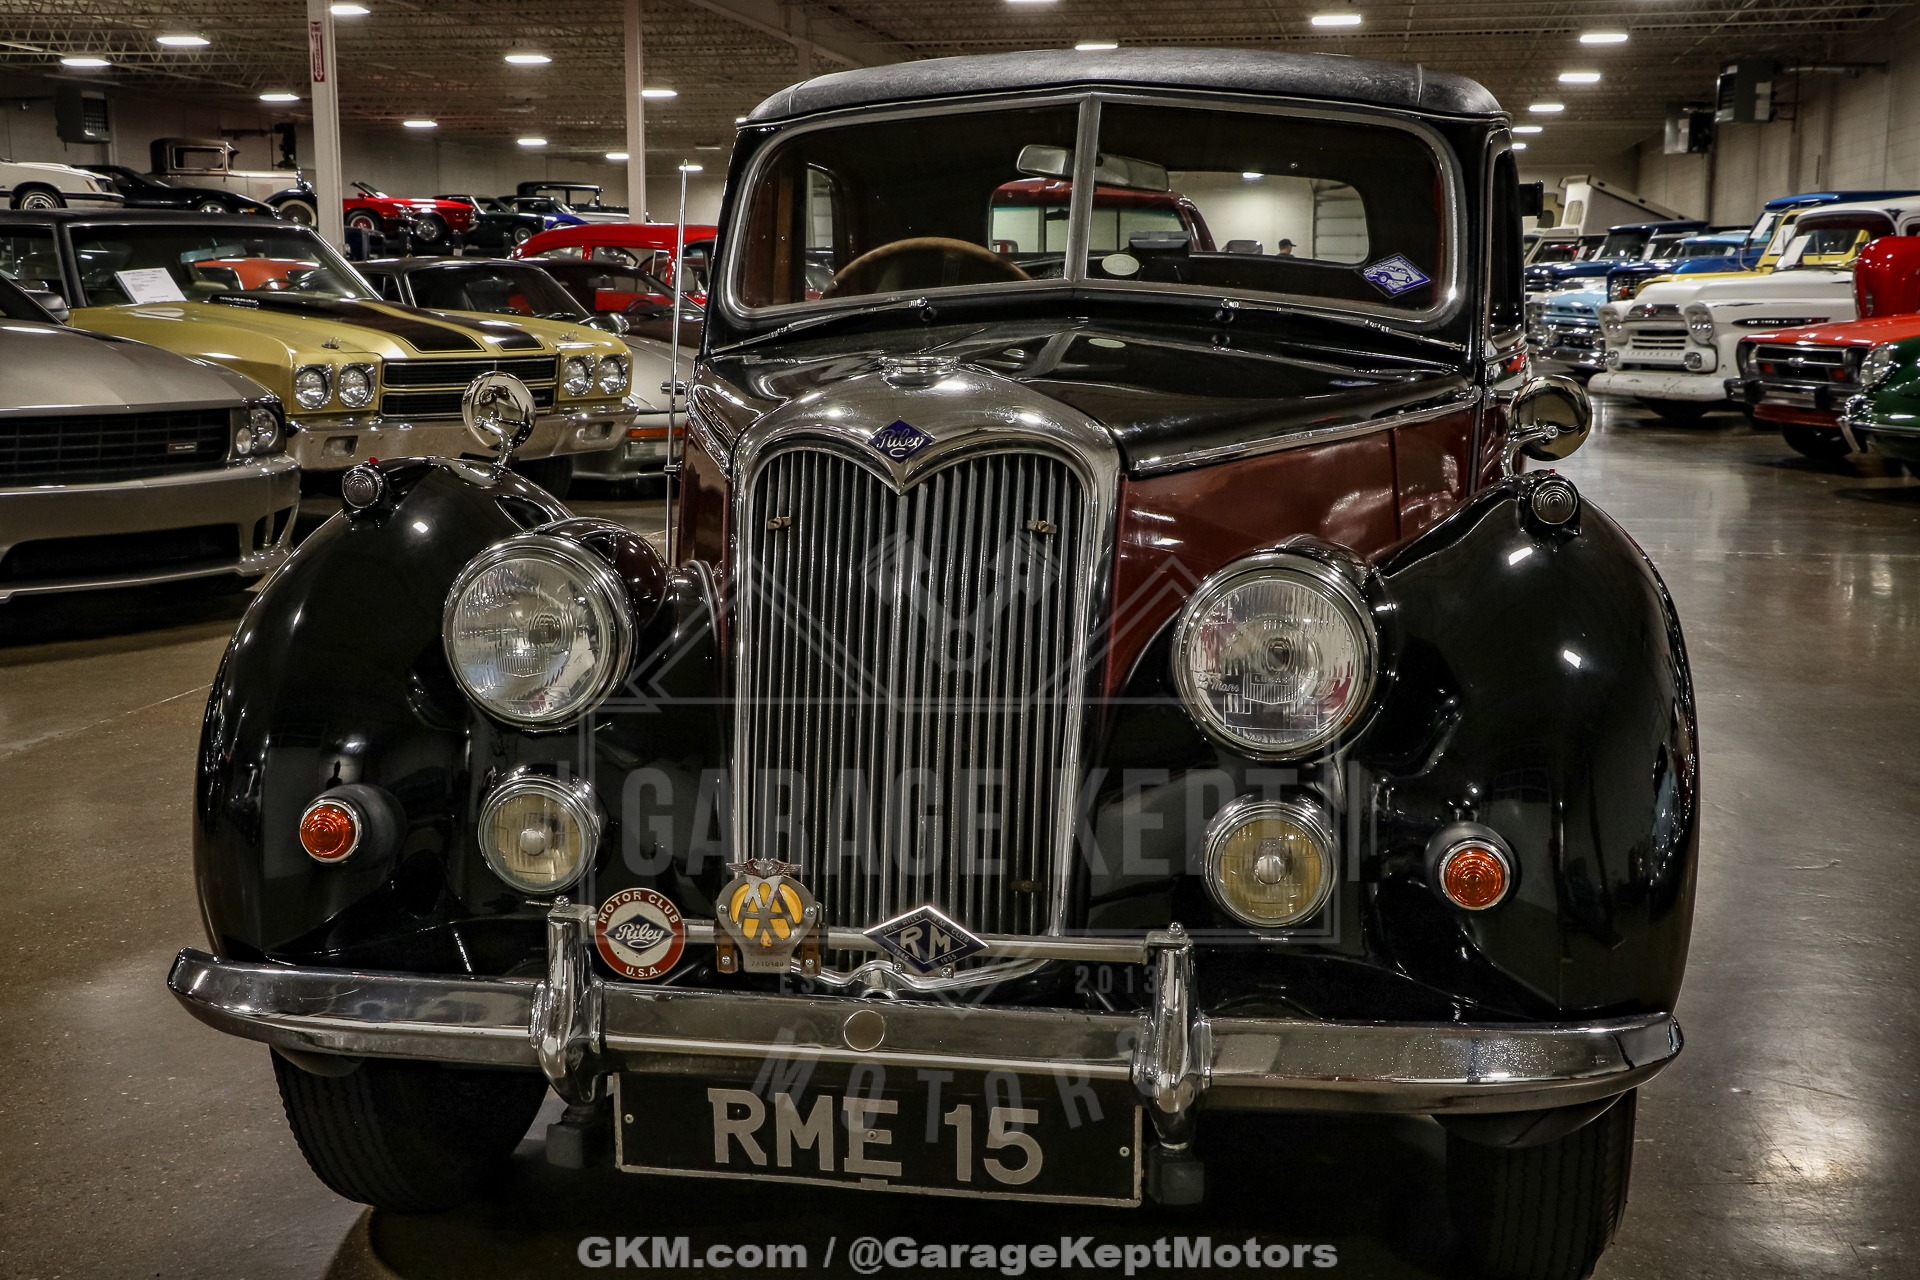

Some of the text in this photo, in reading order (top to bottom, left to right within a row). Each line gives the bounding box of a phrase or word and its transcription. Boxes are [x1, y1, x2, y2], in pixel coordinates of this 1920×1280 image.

[876, 428, 925, 458] Riley
[599, 891, 680, 924] MOTOR CLUB
[615, 923, 664, 949] Riley
[882, 924, 898, 934] THE
[951, 928, 970, 943] CLUB
[893, 947, 910, 961] 1946
[940, 954, 957, 964] 1955
[626, 966, 662, 977] U.S.A.
[707, 1087, 1044, 1186] RME 15
